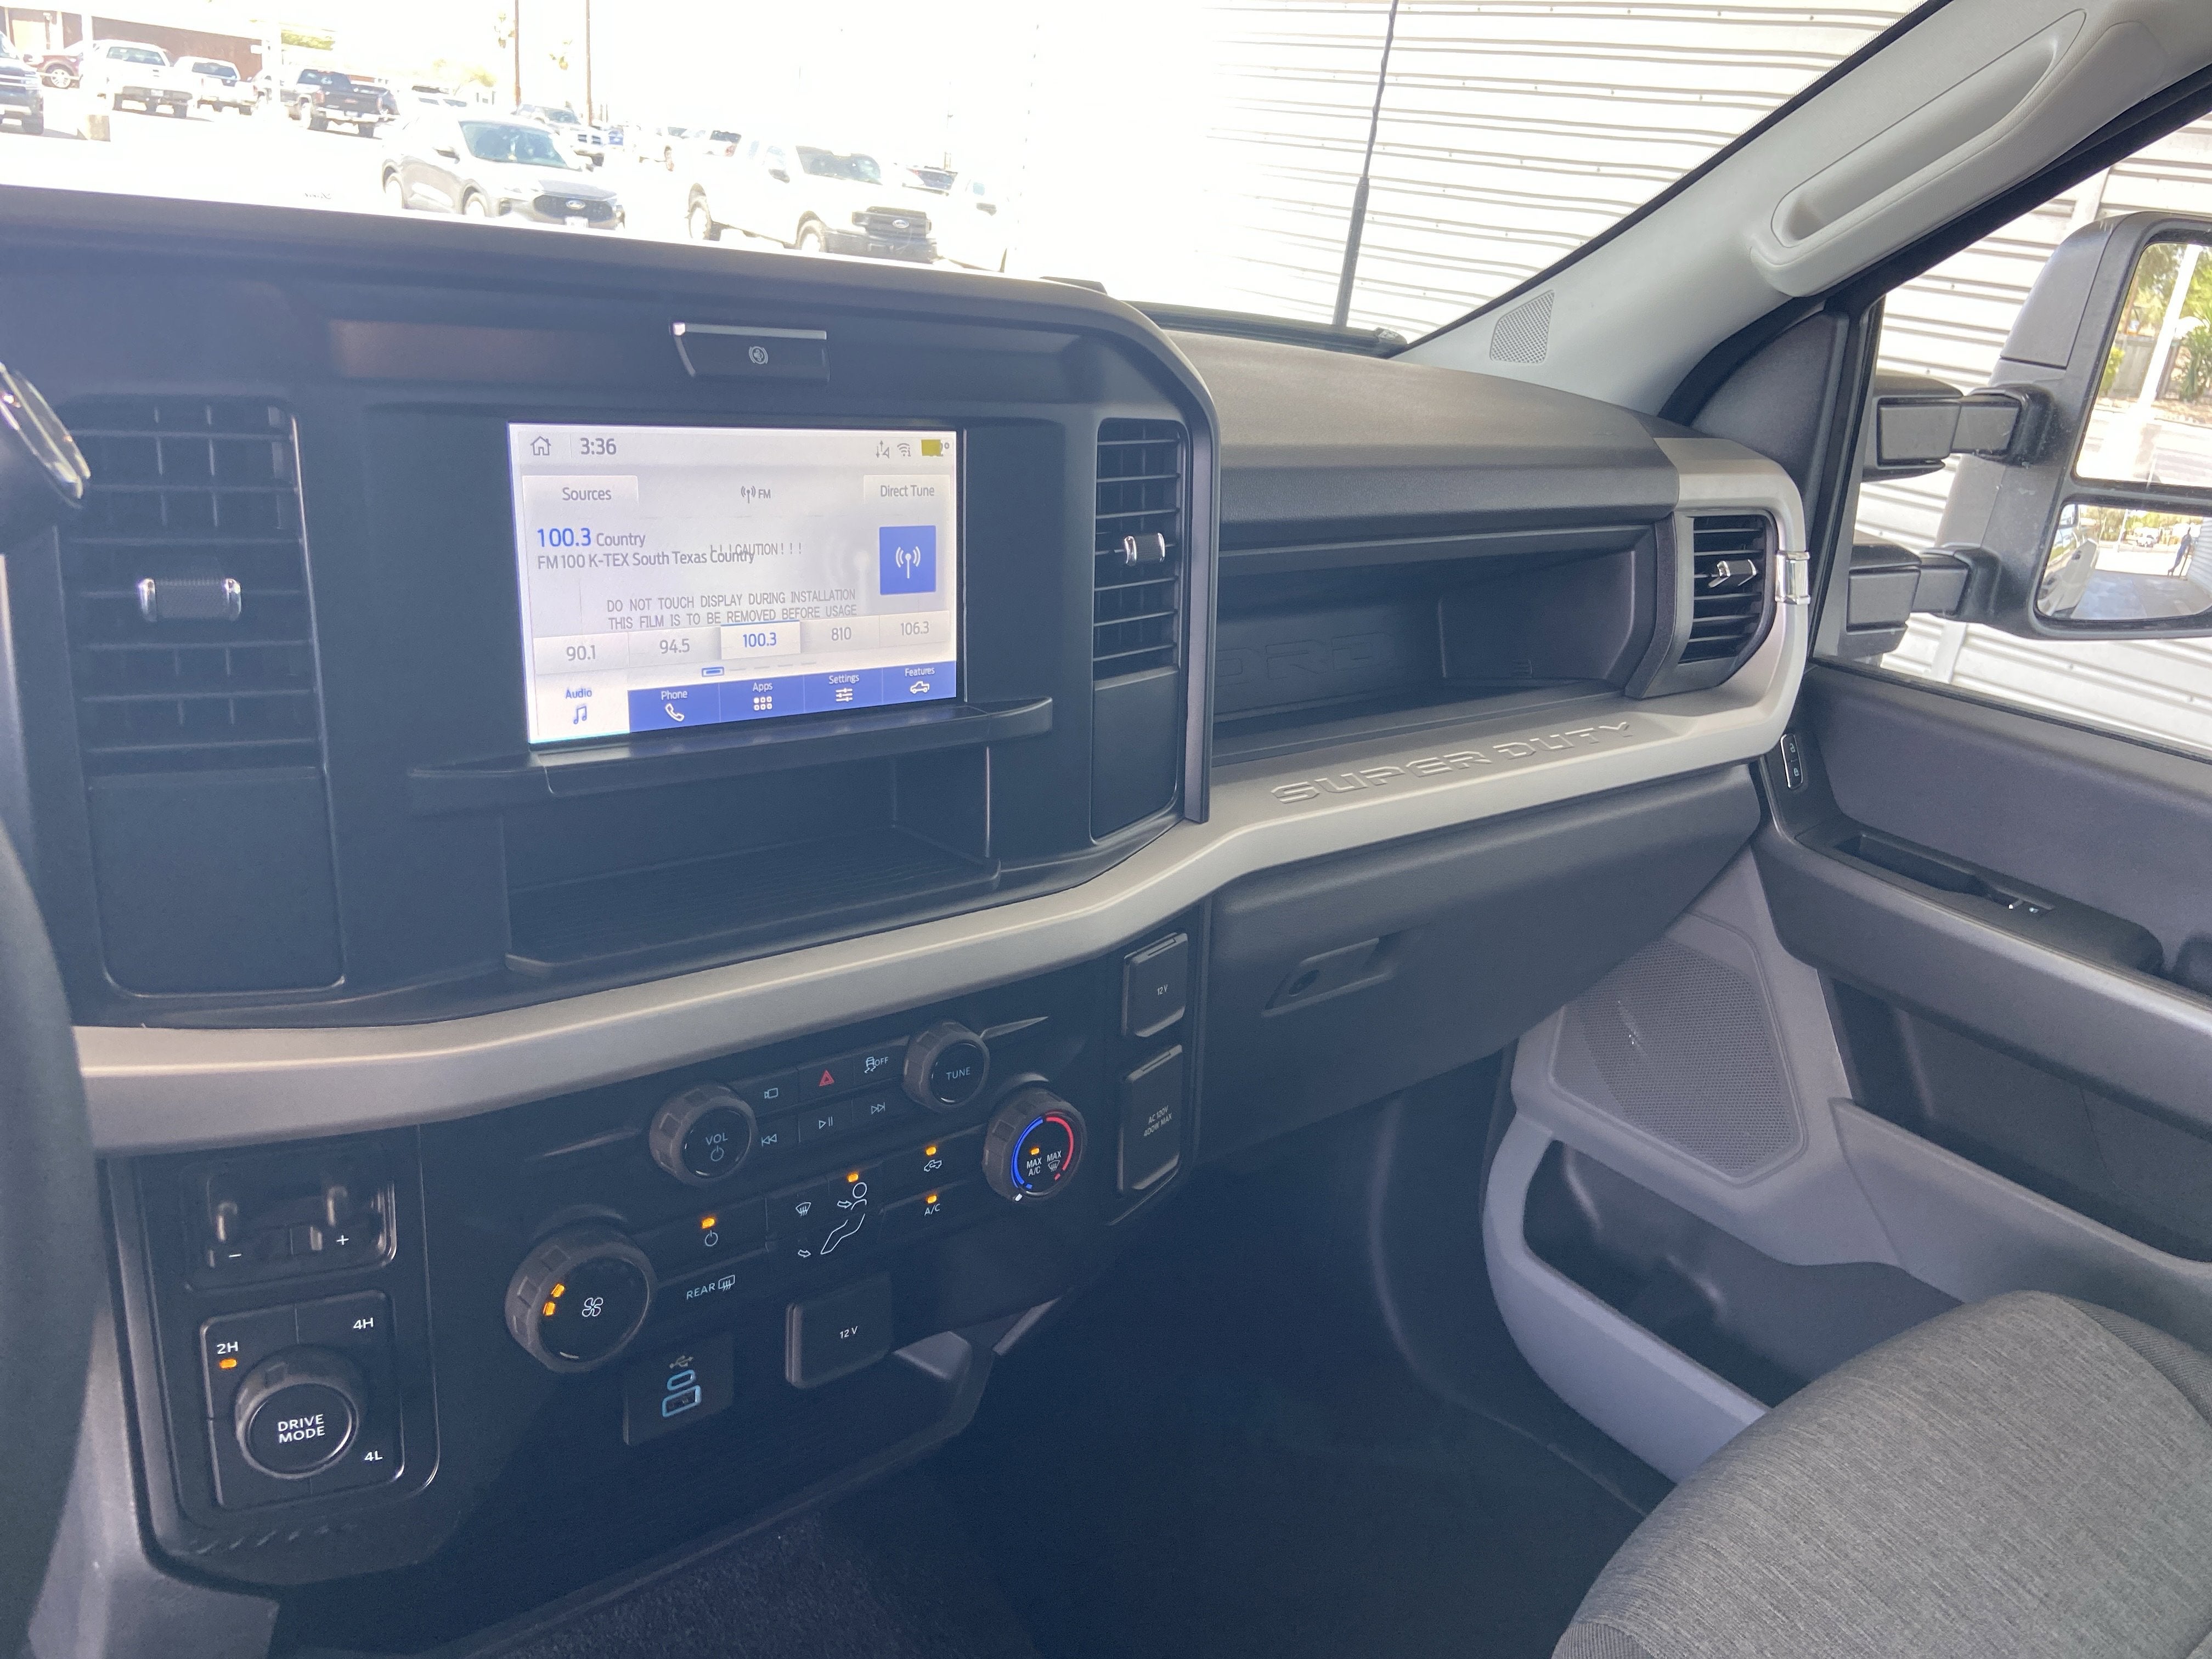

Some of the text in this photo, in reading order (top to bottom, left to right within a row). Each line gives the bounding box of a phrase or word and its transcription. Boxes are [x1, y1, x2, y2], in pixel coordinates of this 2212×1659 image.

[580, 438, 617, 455] 3:36
[562, 486, 612, 501] Sources
[758, 489, 771, 499] FM
[880, 484, 935, 498] Direct Tune
[537, 527, 646, 548] 100.3 Country
[589, 552, 629, 567] K-TEX
[632, 551, 670, 566] South
[672, 550, 708, 565] Texas
[710, 549, 755, 564] Country
[607, 589, 856, 612] DO NOT TOUCH DISPLAY DURING INSTALLATION
[608, 604, 857, 630] THIS FILM IS TO BE REMOVED BEFORE USAGE
[831, 627, 852, 641] 810
[900, 620, 930, 636] 106.3
[659, 637, 691, 654] 94.5
[742, 631, 777, 648] 100.3
[566, 644, 596, 662] 90.1
[904, 666, 935, 677] Features
[828, 673, 860, 685] Settings
[565, 688, 593, 699] Audio
[752, 682, 773, 693] Apps
[661, 690, 689, 701] Phone
[1270, 721, 1633, 804] SUPER DUTY
[874, 1057, 889, 1066] OFF
[946, 1066, 971, 1081] TUNE
[1148, 1114, 1156, 1125] AC
[1161, 1113, 1172, 1126] MAX
[706, 1132, 729, 1146] VOL
[1026, 1156, 1042, 1169] MAX
[1047, 1150, 1062, 1163] MAX
[1028, 1165, 1041, 1177] A/C
[924, 1203, 940, 1216] A/C
[686, 1283, 716, 1300] REAR
[353, 1317, 375, 1330] 4H
[216, 1341, 239, 1355] 2H
[277, 1413, 325, 1432] DRIVE
[278, 1425, 326, 1444] MODE
[364, 1451, 383, 1462] 4L
